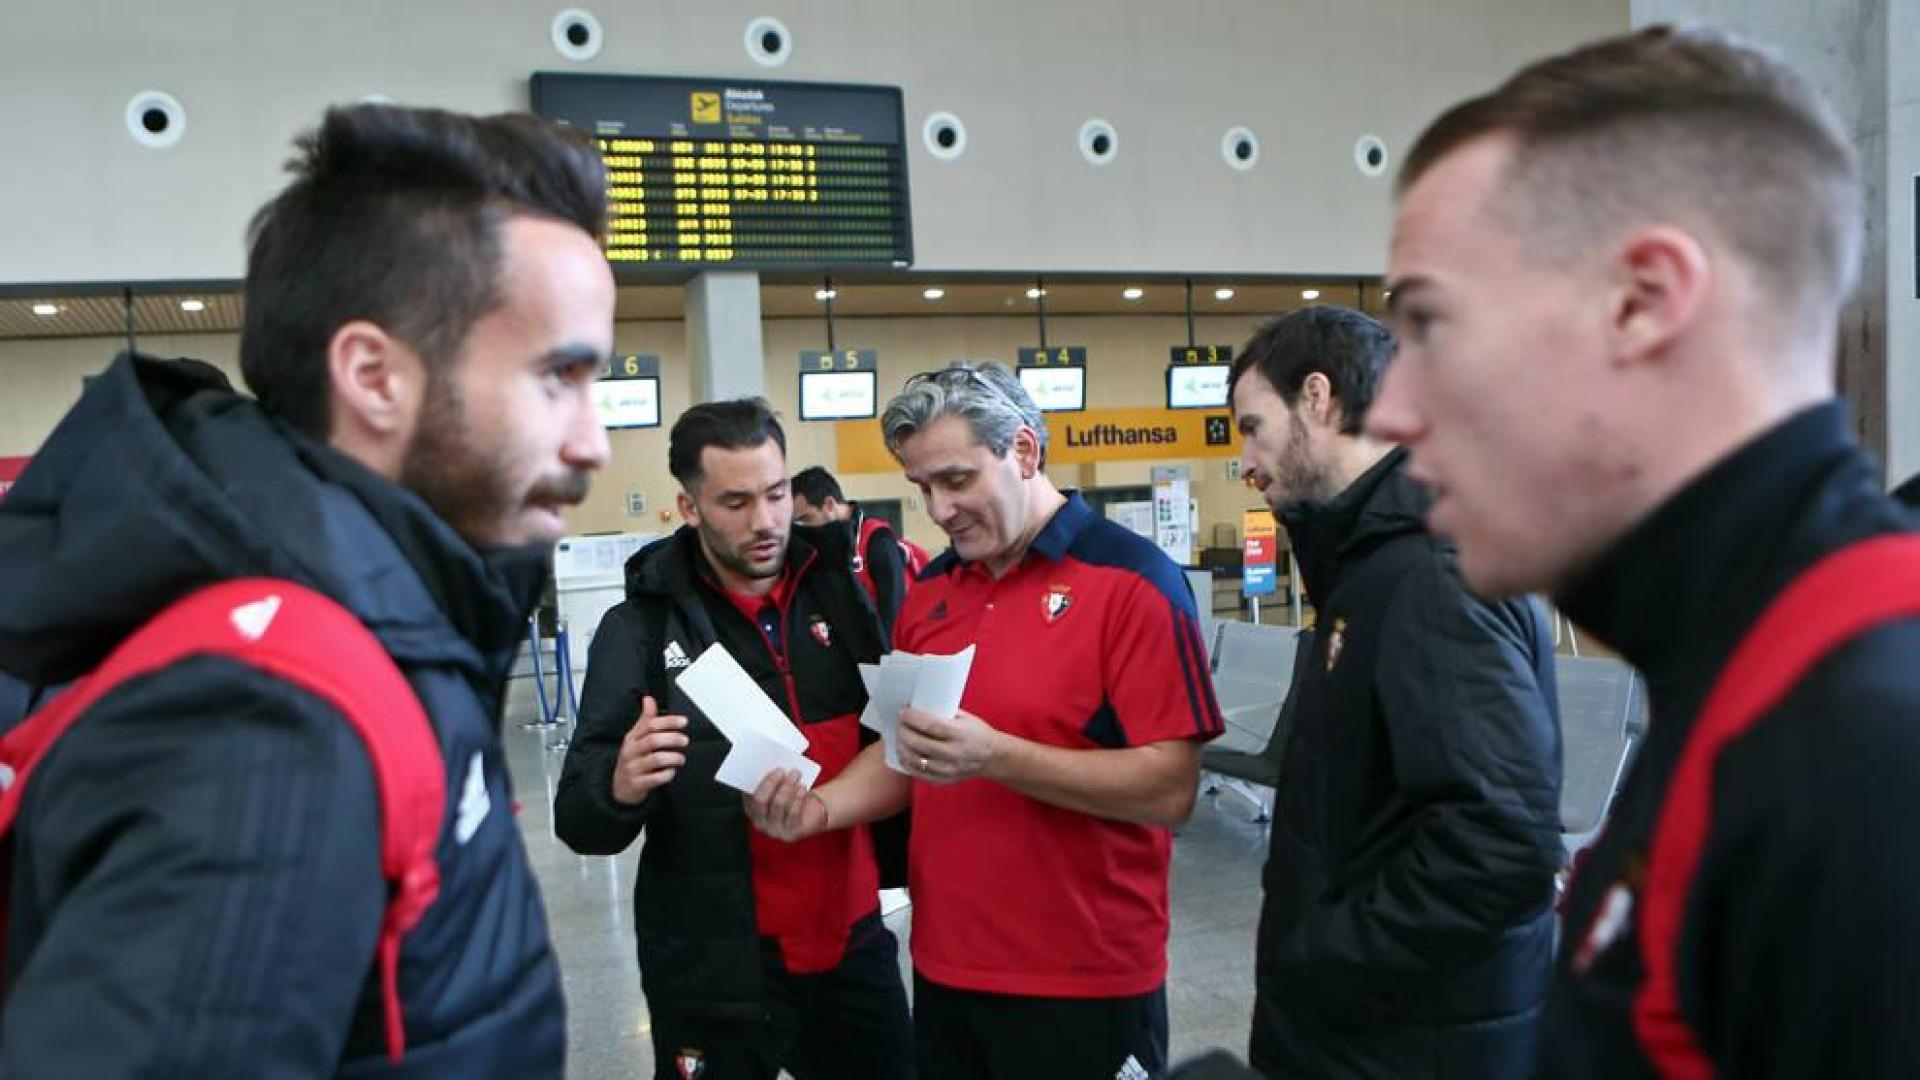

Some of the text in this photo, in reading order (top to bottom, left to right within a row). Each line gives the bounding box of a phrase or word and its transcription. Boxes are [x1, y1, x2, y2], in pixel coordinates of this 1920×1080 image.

[845, 351, 858, 369] 5
[1057, 348, 1069, 364] 4
[1207, 345, 1218, 363] 3
[624, 356, 639, 374] 6
[1066, 424, 1178, 447] Lufthansa
